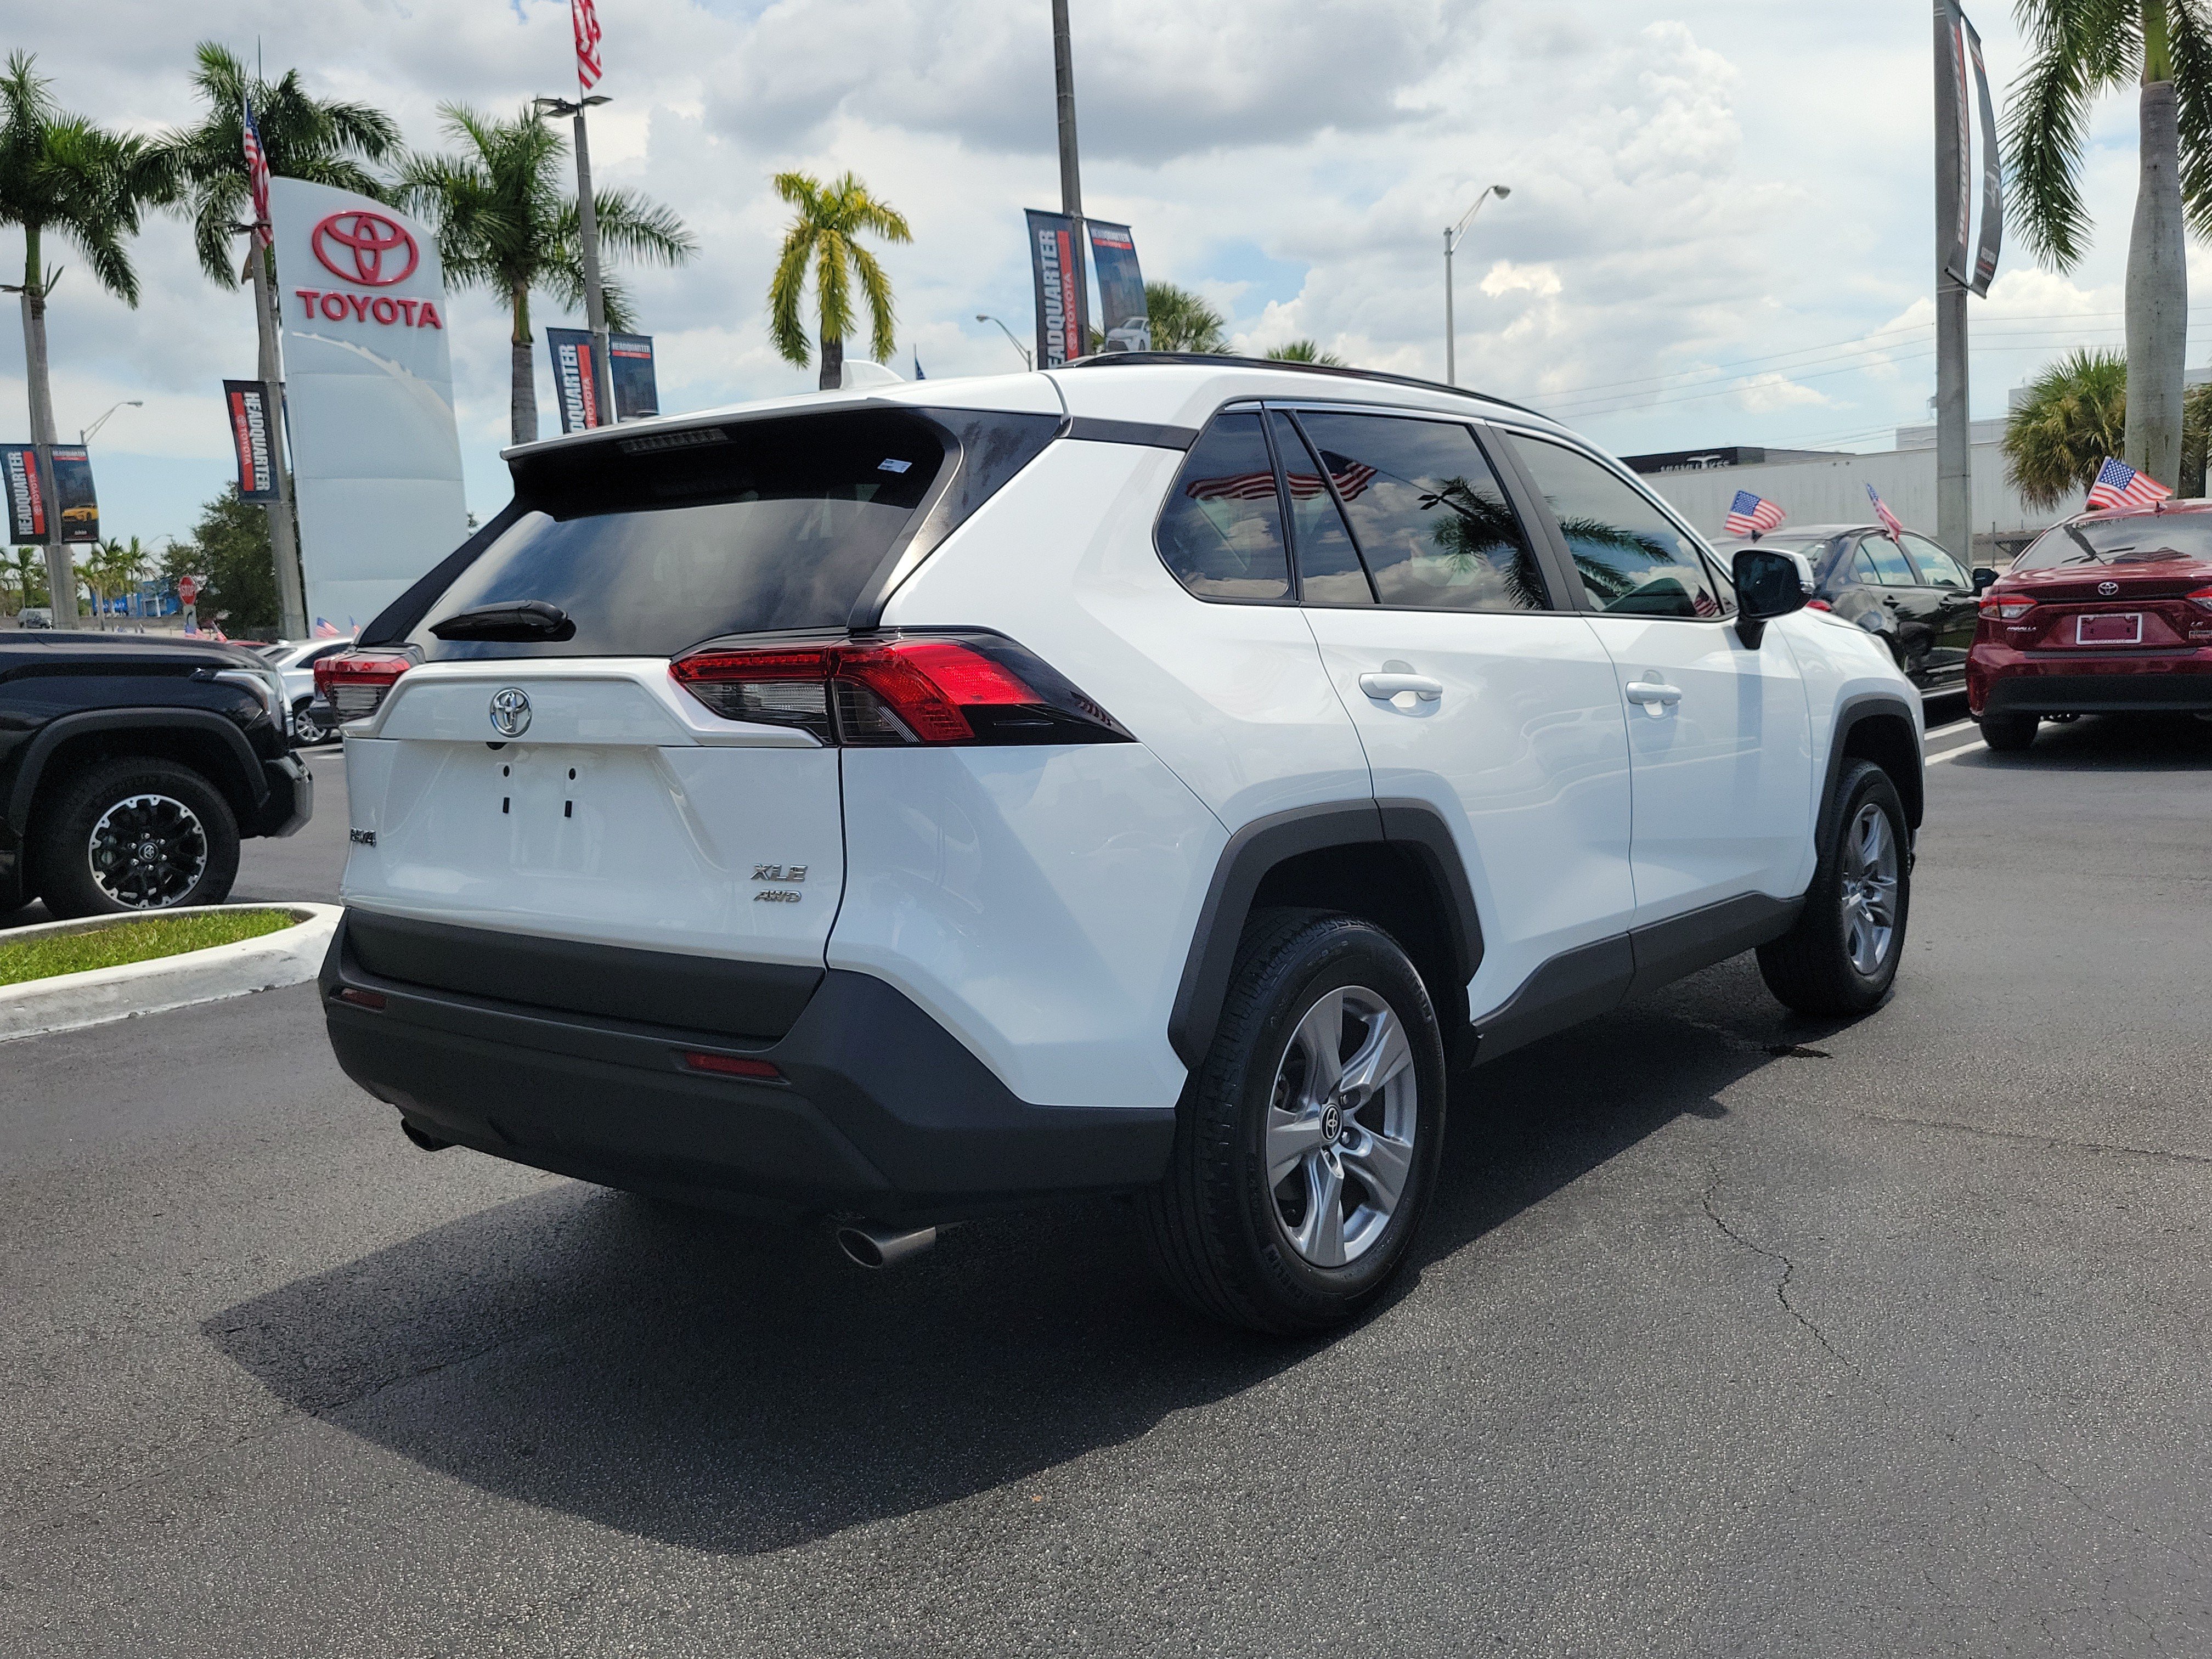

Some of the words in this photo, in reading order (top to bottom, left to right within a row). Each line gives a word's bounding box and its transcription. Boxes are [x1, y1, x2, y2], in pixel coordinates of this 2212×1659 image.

[296, 290, 443, 330] TOYOTA
[1063, 273, 1077, 329] TOYOTA
[582, 377, 595, 422] TOYOTA
[240, 428, 252, 465] TOYOTA
[244, 391, 270, 492] HEADQUARTER
[7, 452, 34, 535] HEADQUARTER
[29, 473, 43, 505] TOYOTA
[181, 584, 195, 596] STOP
[750, 863, 809, 882] XLE
[753, 889, 802, 902] AWD
